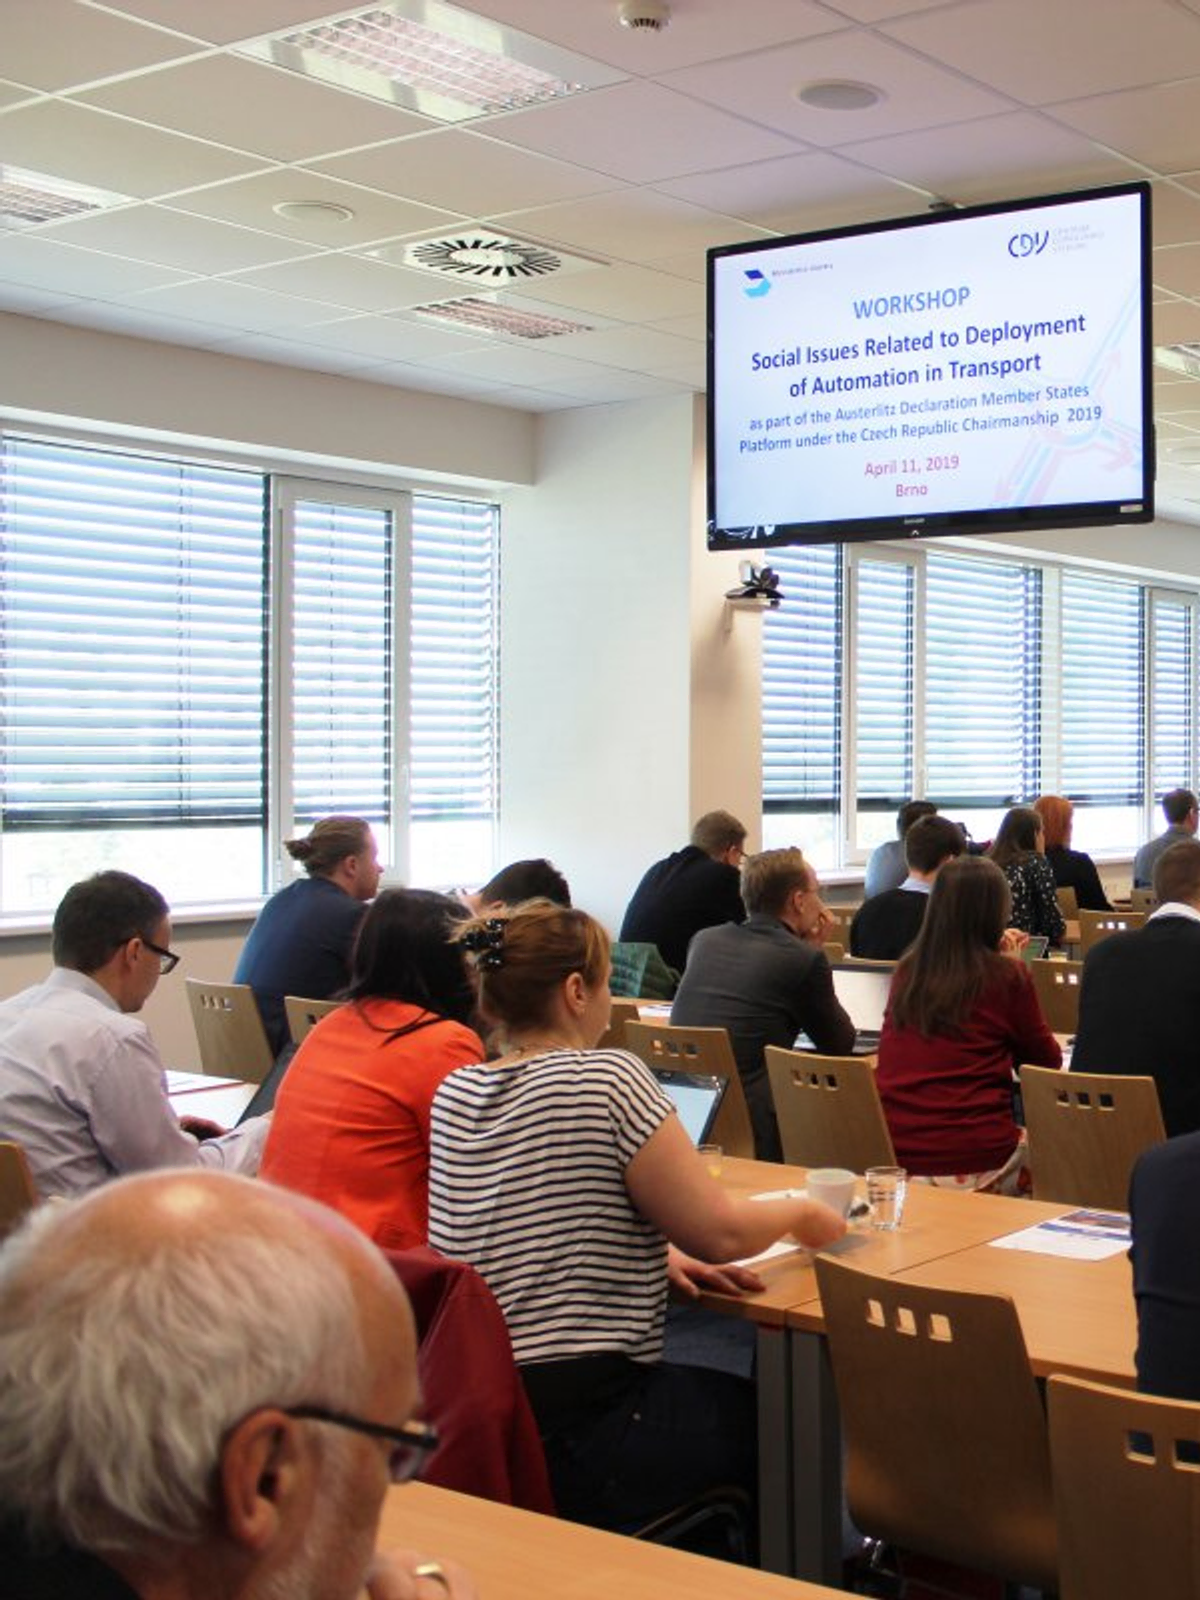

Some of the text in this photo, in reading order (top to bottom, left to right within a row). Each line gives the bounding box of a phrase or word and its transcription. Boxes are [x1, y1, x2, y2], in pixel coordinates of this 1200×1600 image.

[852, 286, 971, 319] WORKSHOP
[751, 314, 1086, 371] Social Issues Related to Deployment
[789, 353, 1042, 398] of Automation in Transport
[739, 406, 1102, 452] Platform under the Czech Republic Chairmanship 2019
[749, 382, 1089, 431] as part of the Austerlitz Declaration Member States
[864, 455, 960, 477] April 11, 2019
[895, 484, 928, 497] Brno
